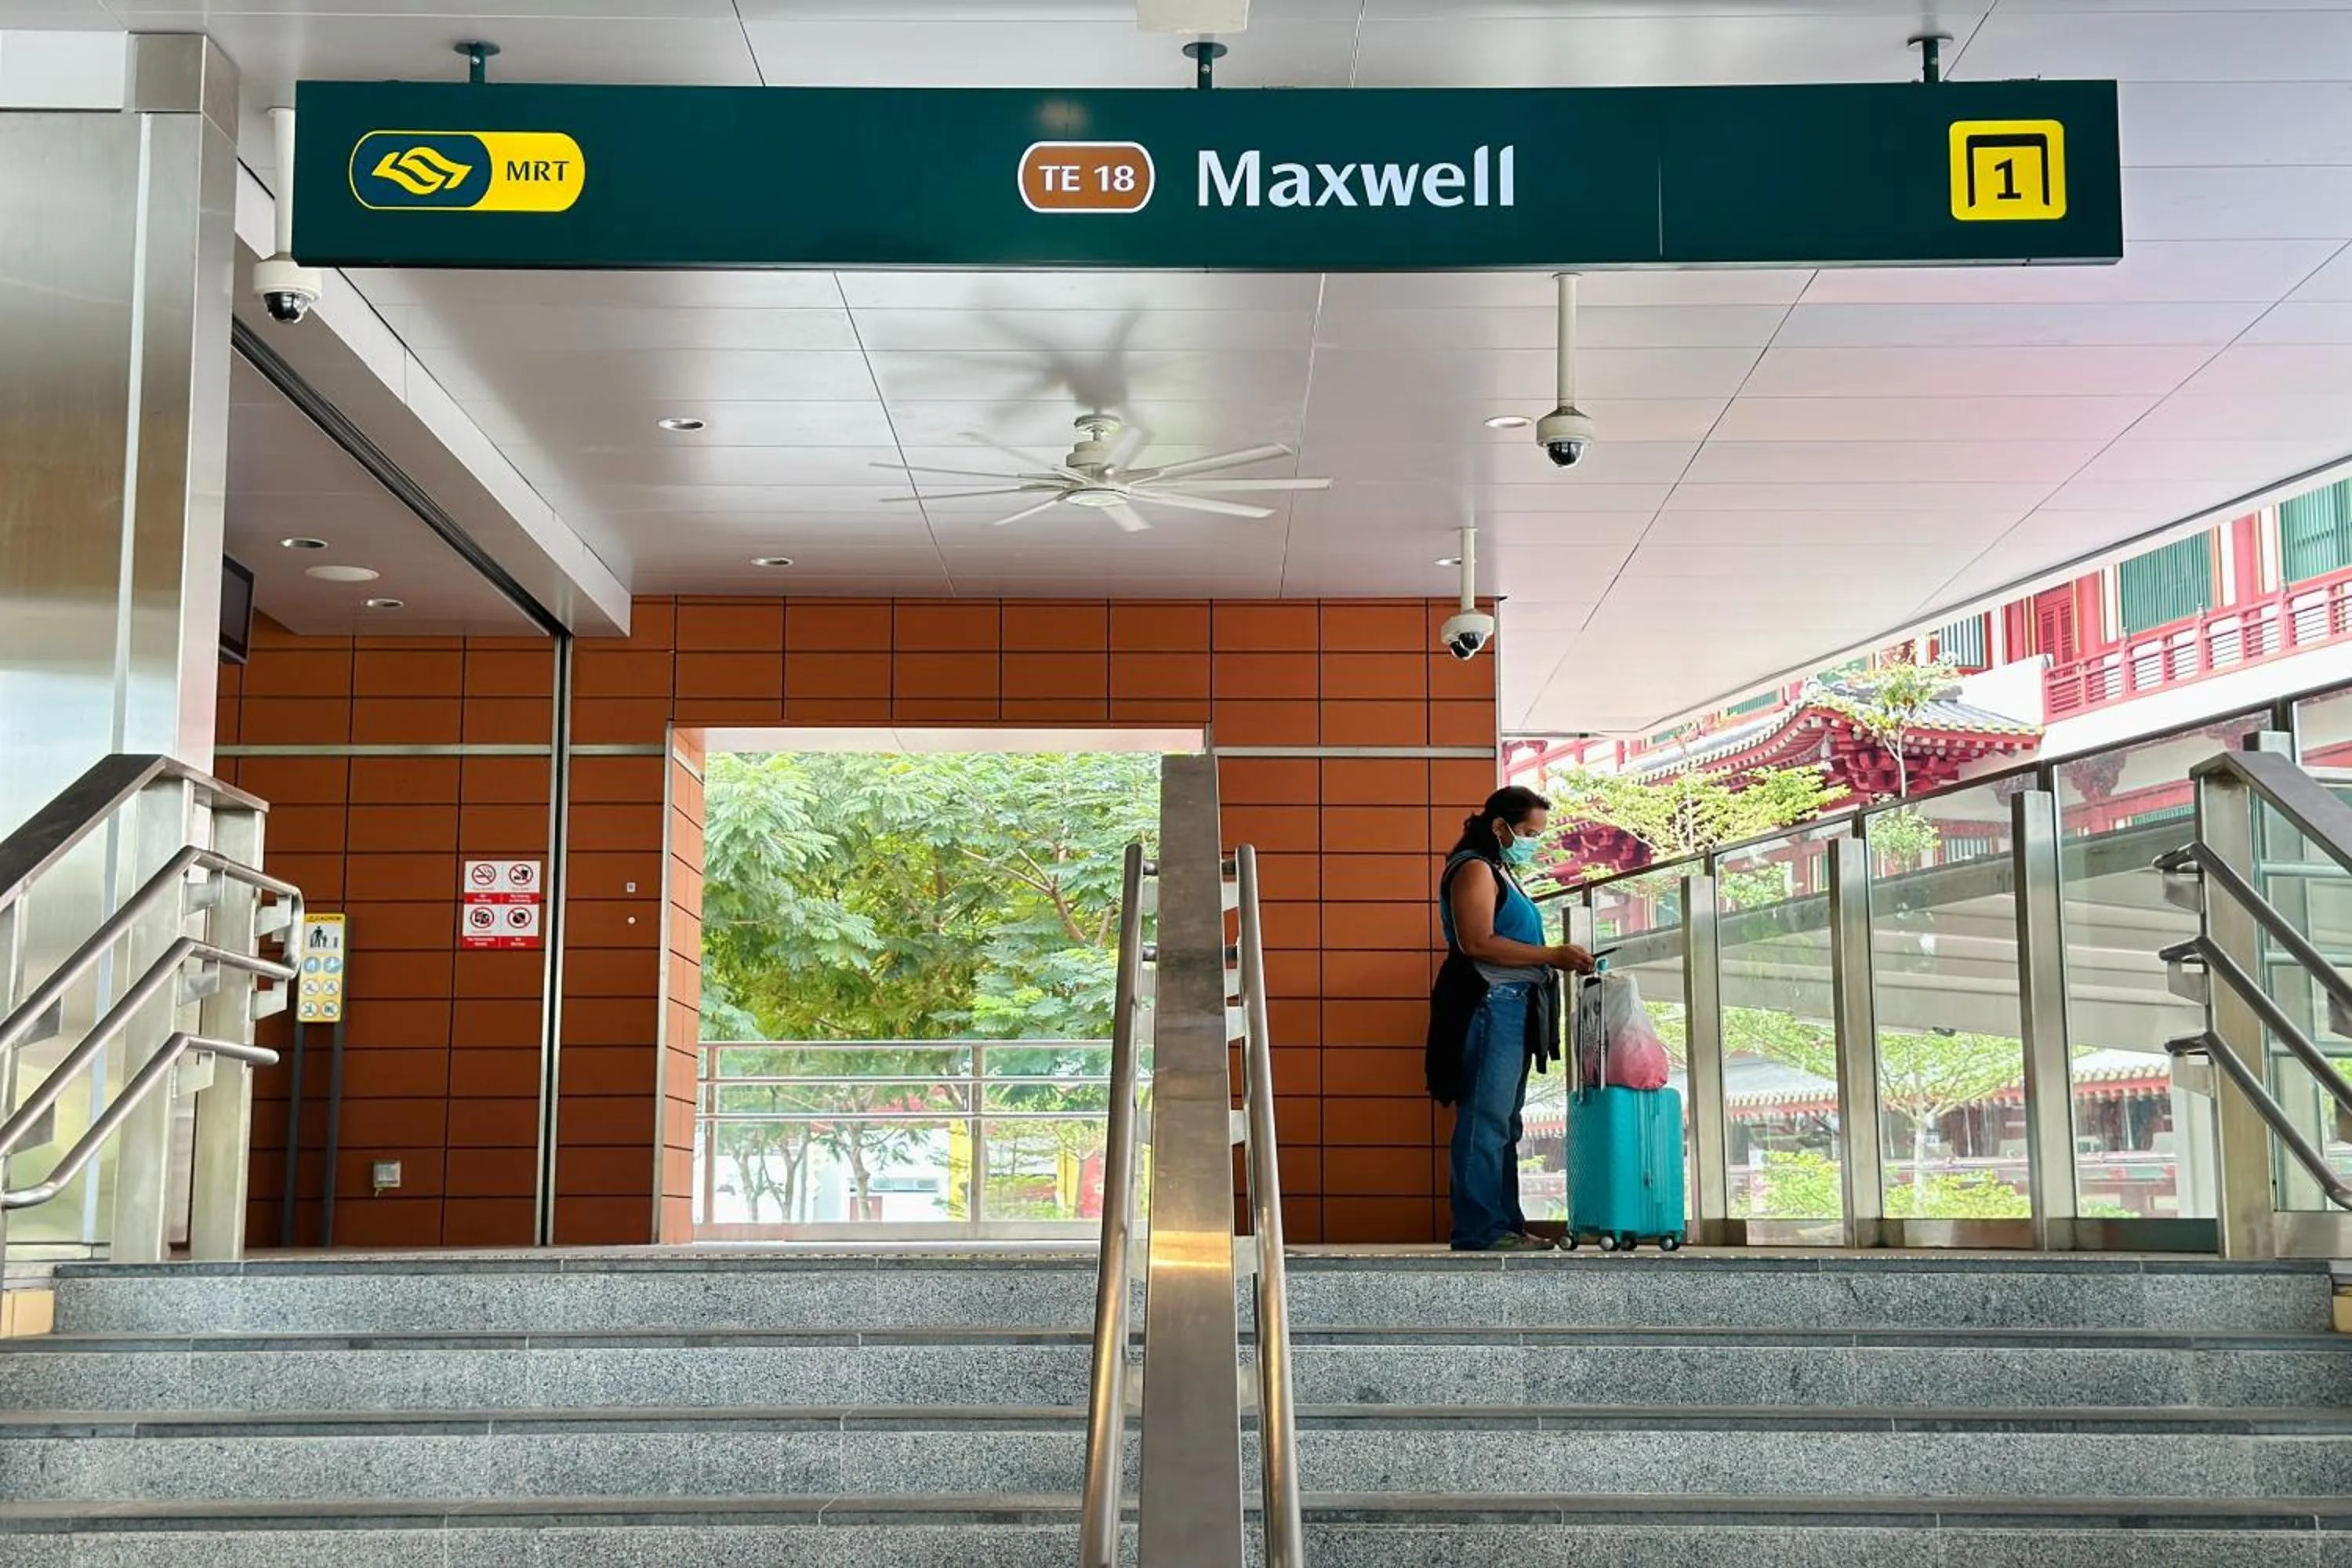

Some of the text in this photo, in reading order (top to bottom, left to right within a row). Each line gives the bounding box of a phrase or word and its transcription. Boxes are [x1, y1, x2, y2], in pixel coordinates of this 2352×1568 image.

[506, 160, 570, 181] MRT
[1038, 164, 1135, 192] TE 18
[1197, 144, 1515, 207] Maxwell
[1994, 158, 2023, 200] 1
